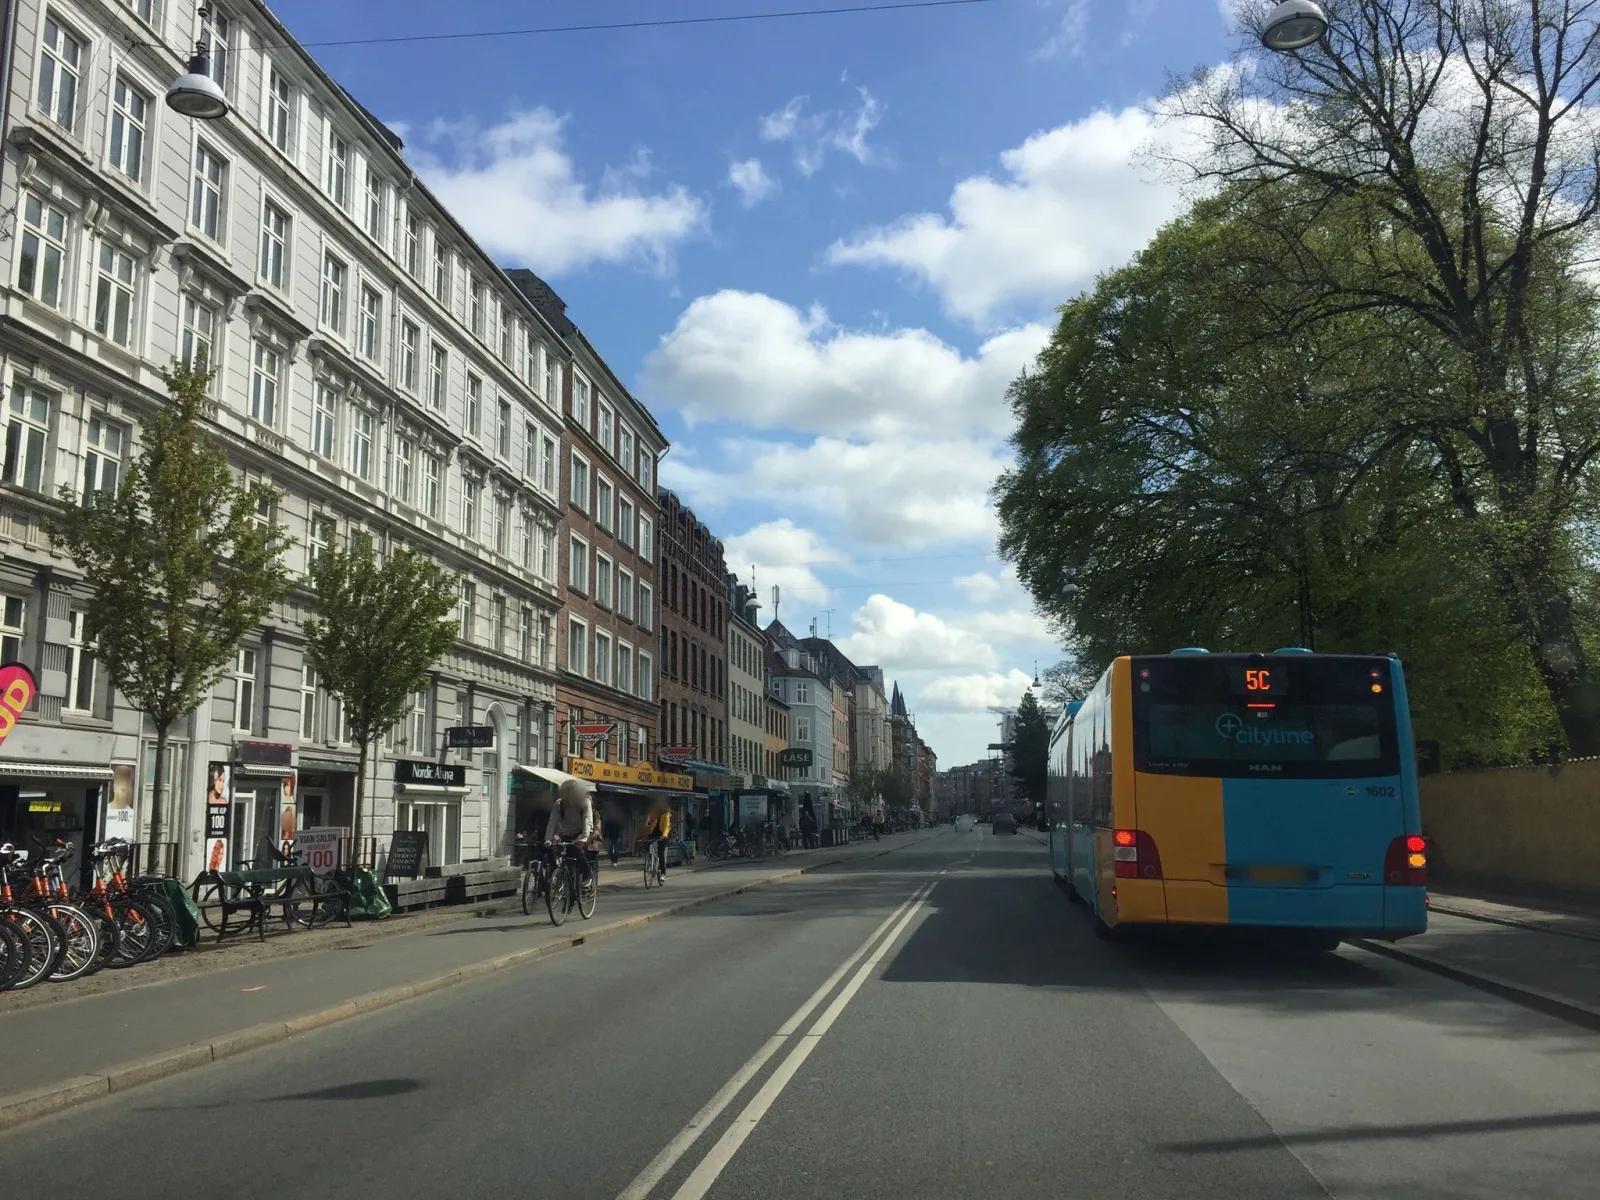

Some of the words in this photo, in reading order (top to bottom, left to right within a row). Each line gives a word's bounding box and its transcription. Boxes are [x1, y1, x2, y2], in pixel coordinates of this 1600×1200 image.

[1246, 670, 1271, 690] 5C
[1235, 726, 1314, 746] cityline
[412, 763, 433, 779] Nordic
[434, 765, 454, 784] Abaya
[1365, 785, 1395, 798] 1602
[211, 815, 225, 829] 100
[299, 834, 315, 844] VIAN
[316, 833, 337, 843] SALON
[305, 850, 333, 868] 100
